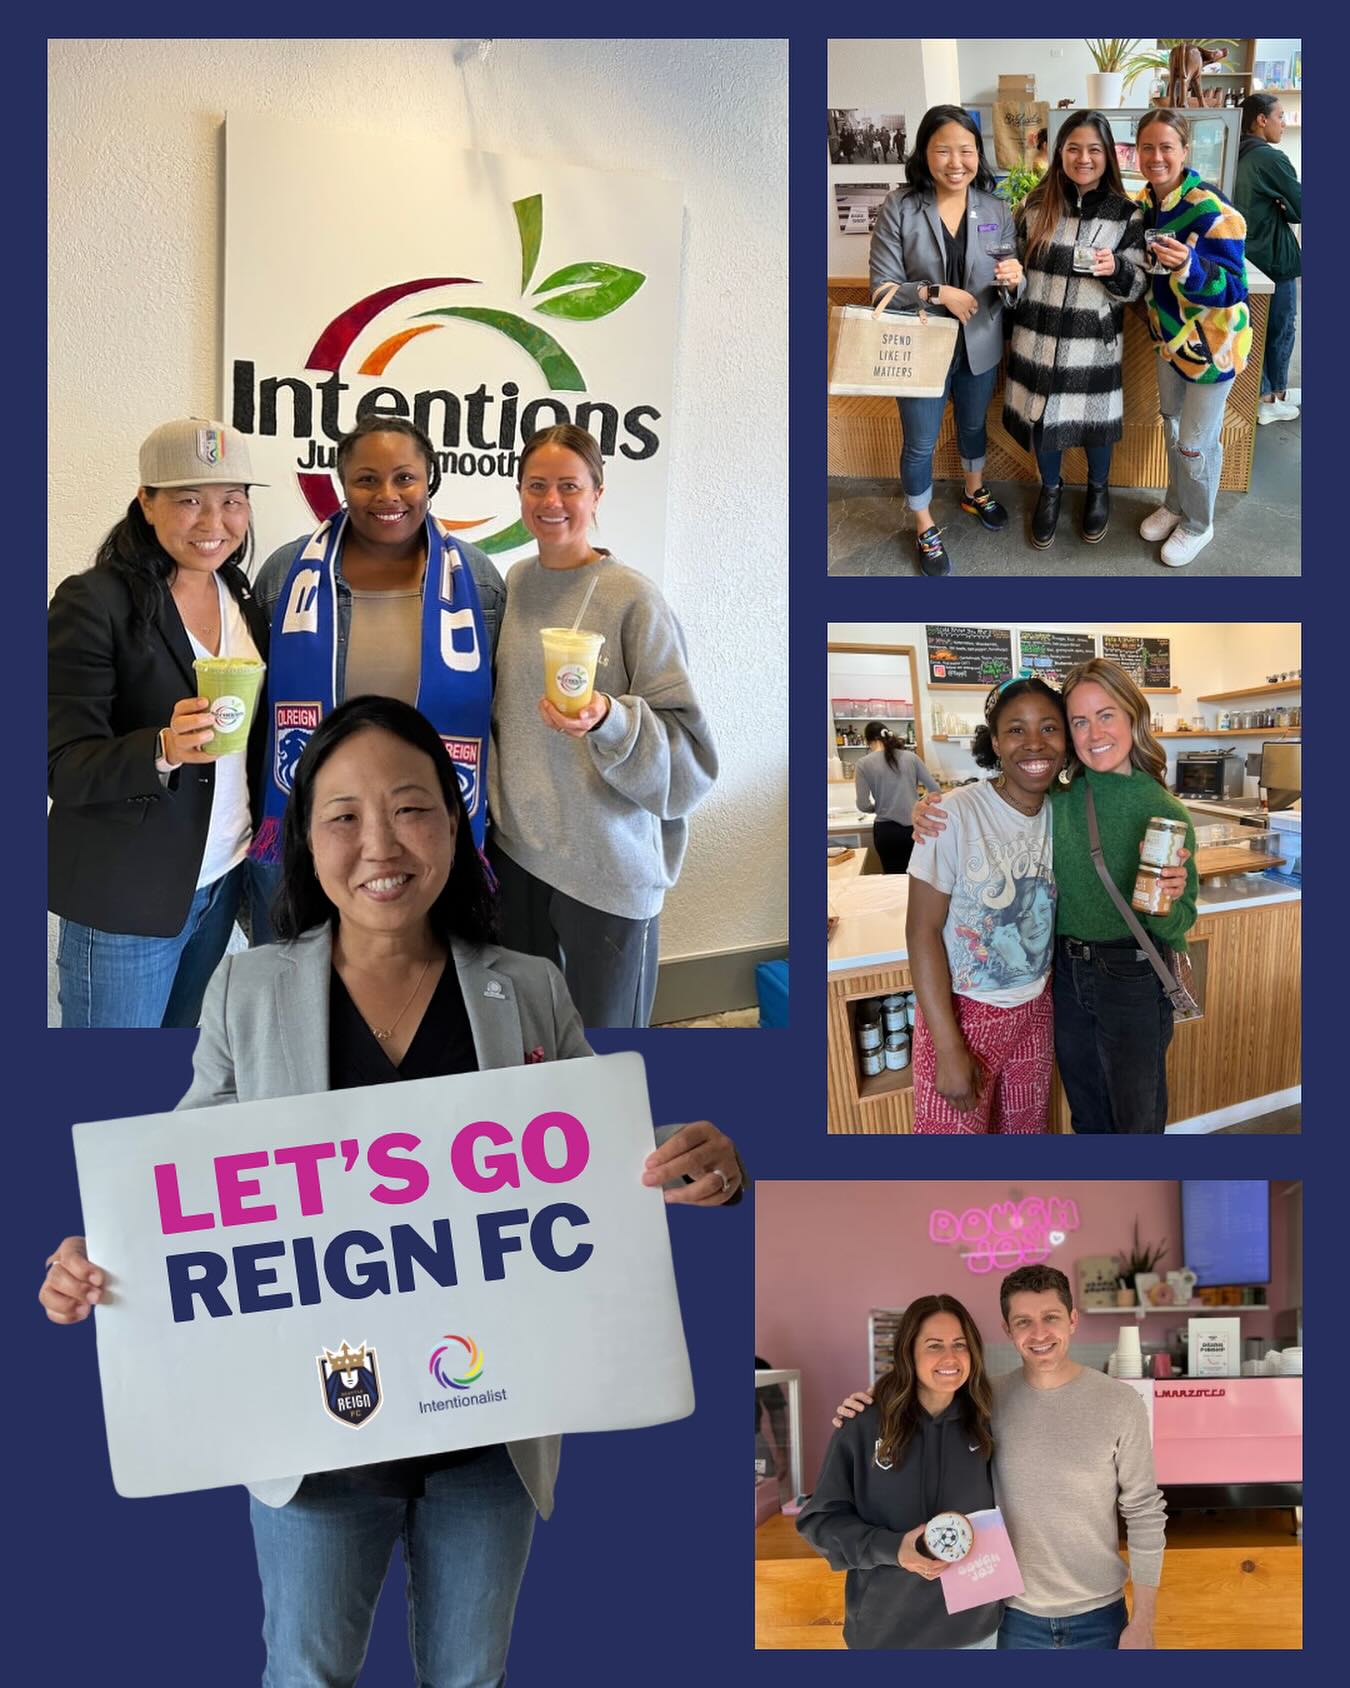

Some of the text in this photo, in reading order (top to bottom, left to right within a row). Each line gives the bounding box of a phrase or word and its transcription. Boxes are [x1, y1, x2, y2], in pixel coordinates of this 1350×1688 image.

[879, 350, 911, 362] LIKE IT
[882, 333, 911, 346] SPEND
[873, 365, 913, 378] MATTERS
[232, 359, 662, 461] Intentions
[153, 1111, 590, 1235] LET’S GO
[928, 1196, 1080, 1243] DOUGH
[166, 1202, 594, 1323] REIGN FC
[419, 1389, 508, 1413] Intentionalist
